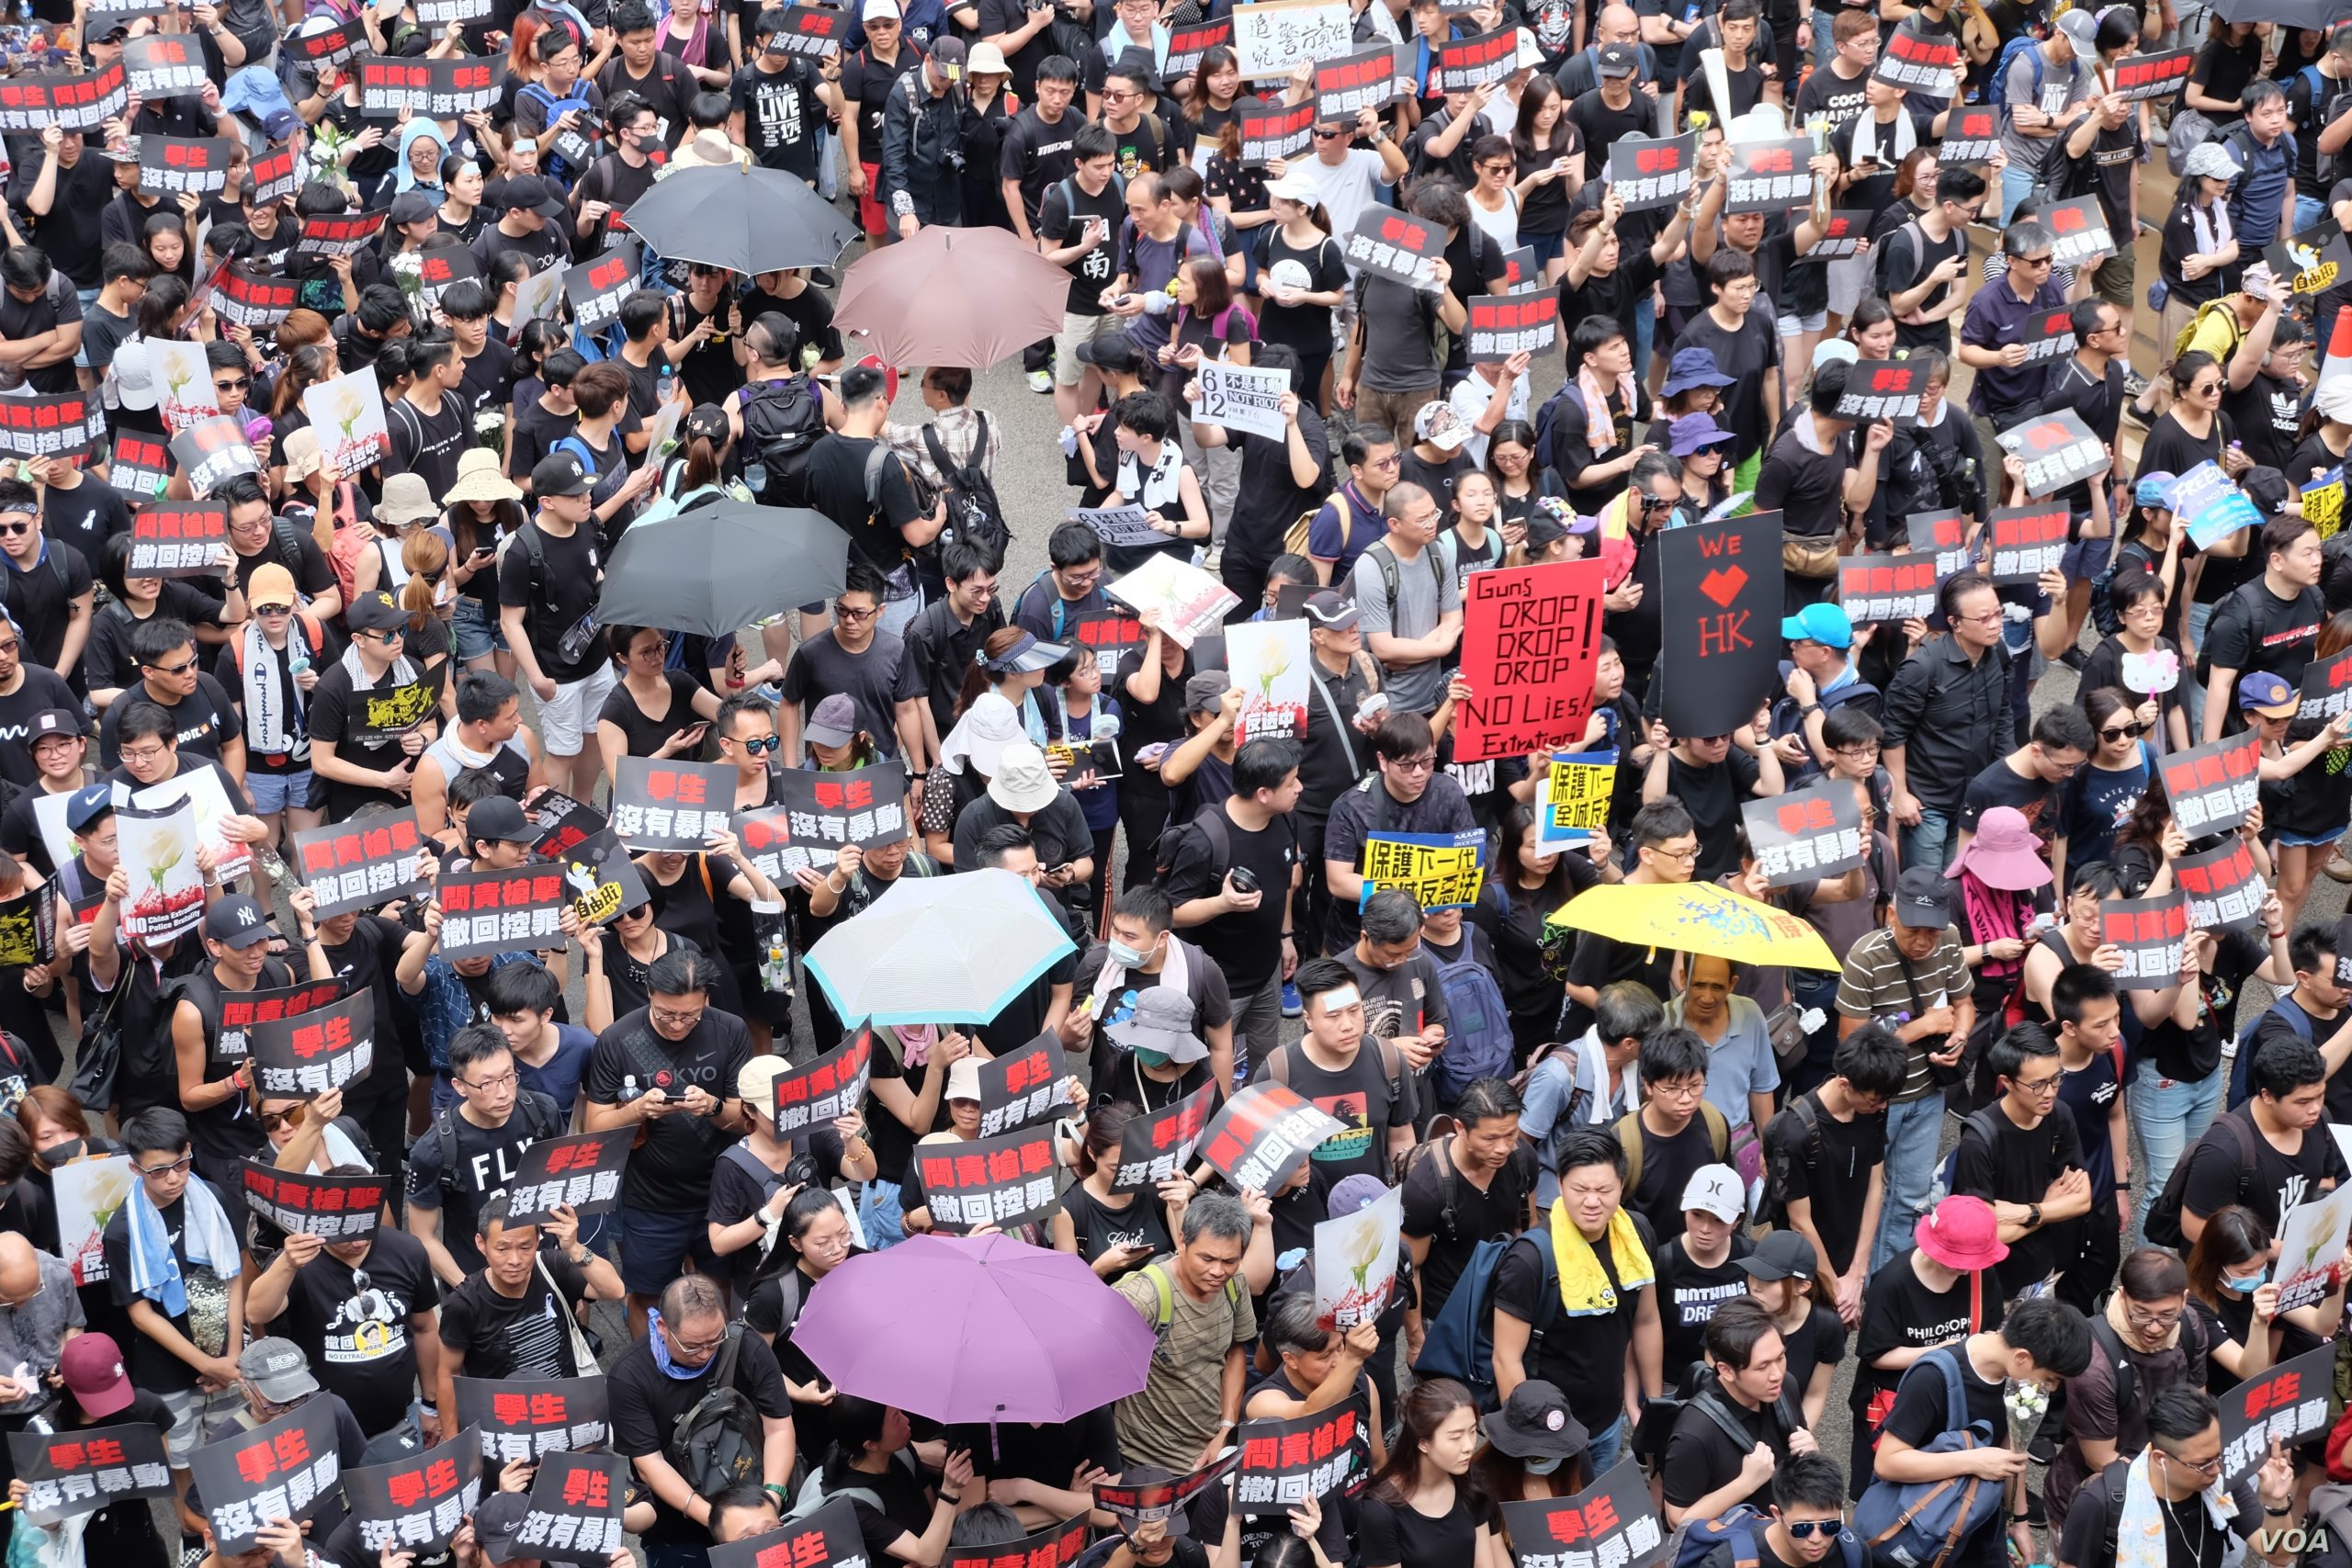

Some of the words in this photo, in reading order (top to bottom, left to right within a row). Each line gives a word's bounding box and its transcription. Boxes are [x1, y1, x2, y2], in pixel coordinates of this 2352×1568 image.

[759, 92, 800, 121] LIVE
[164, 145, 208, 168] 學生
[141, 167, 228, 193] 沒有暴動
[1202, 368, 1217, 392] 6
[1228, 391, 1252, 404] NOT
[1199, 391, 1227, 418] 12
[134, 512, 227, 539] 問責槍擊
[1698, 533, 1742, 558] WE
[1499, 595, 1579, 629] DROP
[1497, 626, 1574, 659] DROP
[1698, 610, 1754, 658] HK
[1494, 657, 1569, 686] DROP
[1464, 695, 1513, 728] NO
[647, 771, 707, 805] 學生
[813, 780, 875, 810] 學生
[616, 803, 730, 841] 沒有暴動
[789, 803, 904, 843] 沒有暴動
[301, 820, 418, 873] 問責槍擊
[1370, 840, 1475, 879] 保護下一代
[309, 856, 420, 904] 撤回控罪
[441, 875, 561, 913] 問責槍擊
[126, 917, 147, 933] NO
[148, 914, 169, 924] China
[171, 899, 204, 919] Extradition
[149, 921, 172, 932] Police
[174, 910, 200, 925] Brutality
[442, 907, 560, 949] 撤回控罪
[222, 985, 340, 1027] 問責槍擊
[291, 1016, 353, 1059] 學生
[261, 1040, 373, 1095] 沒有暴動
[1005, 1050, 1053, 1095] 學生
[545, 1141, 605, 1174] 學生
[921, 1138, 1054, 1190] 問責槍擊
[243, 1168, 382, 1212] 問責槍擊
[509, 1168, 620, 1219] 沒有暴動
[929, 1176, 1057, 1225] 撤回控罪
[492, 1393, 567, 1426] 學生
[2245, 1371, 2301, 1419] 學生
[48, 1438, 126, 1471] 學生
[235, 1427, 311, 1484] 學生
[1242, 1410, 1357, 1471] 問責槍擊
[2222, 1396, 2328, 1479] 沒有暴動
[28, 1461, 172, 1513] 沒有暴動
[387, 1458, 459, 1508] 學生
[561, 1469, 609, 1508] 學生
[1238, 1448, 1353, 1506] 撤回控罪
[516, 1510, 623, 1554] 沒有暴動
[1545, 1494, 1620, 1546] 學生
